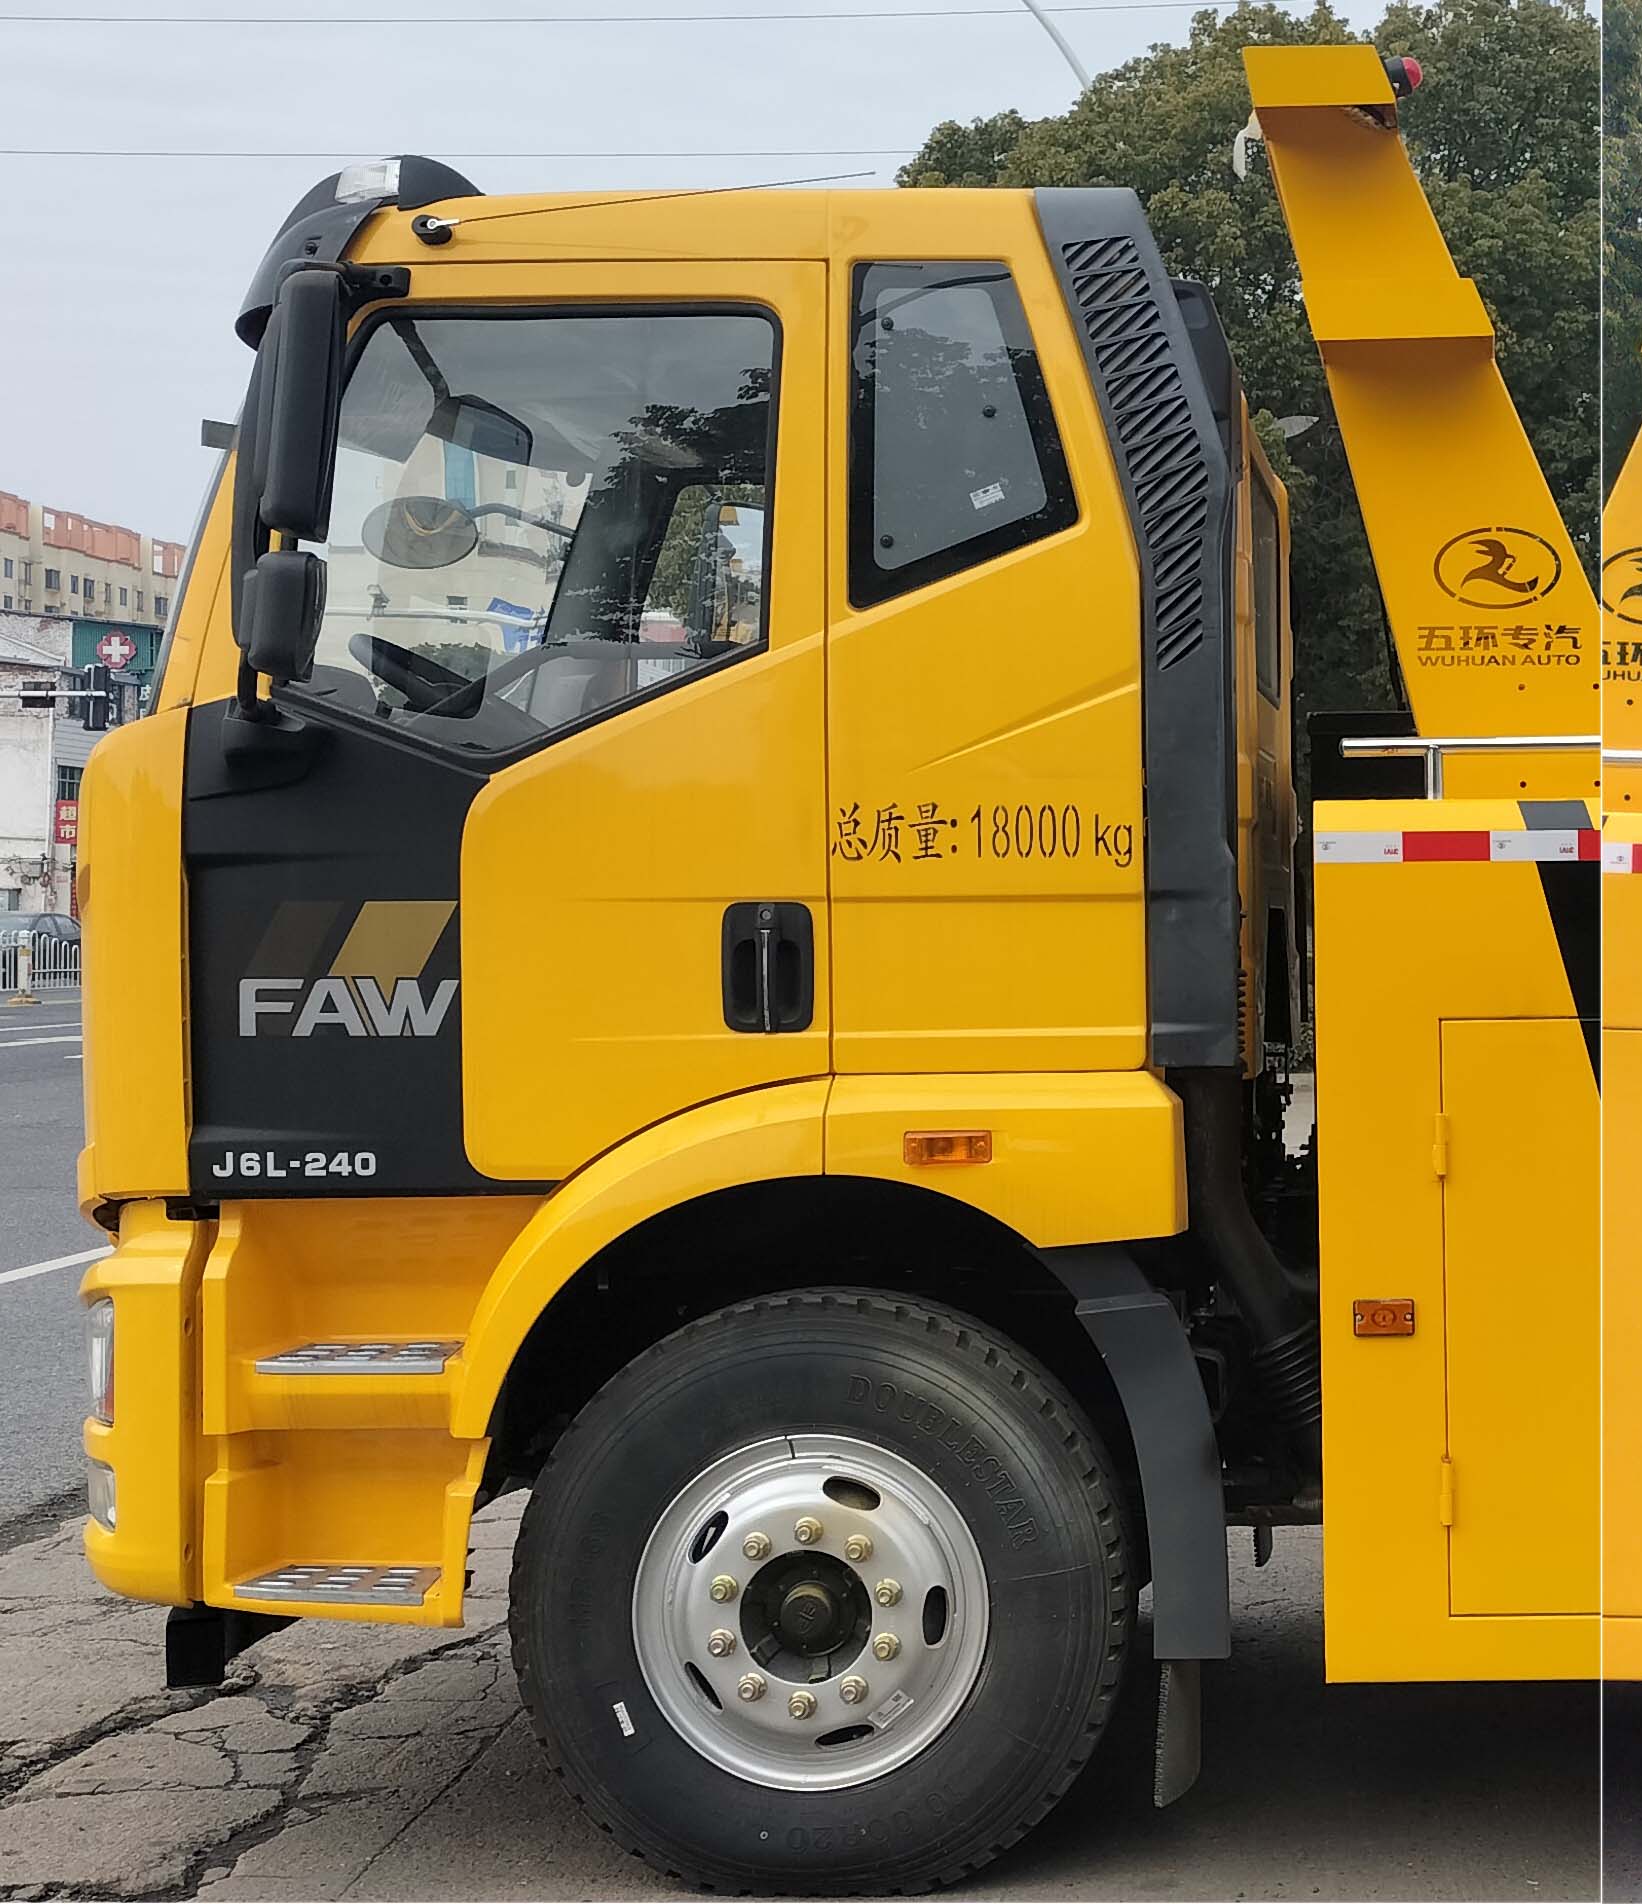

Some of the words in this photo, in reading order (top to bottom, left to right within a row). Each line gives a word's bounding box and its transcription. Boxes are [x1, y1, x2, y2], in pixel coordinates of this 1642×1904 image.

[1416, 624, 1583, 651] 五环专汽
[1417, 654, 1517, 667] WUHUAN
[1521, 654, 1581, 666] AUTO
[59, 805, 77, 839] 超市
[1094, 813, 1133, 868] kg
[238, 977, 460, 1037] FAW
[212, 1151, 377, 1178] J6L-240
[848, 1374, 1039, 1550] DOUBLESTAR
